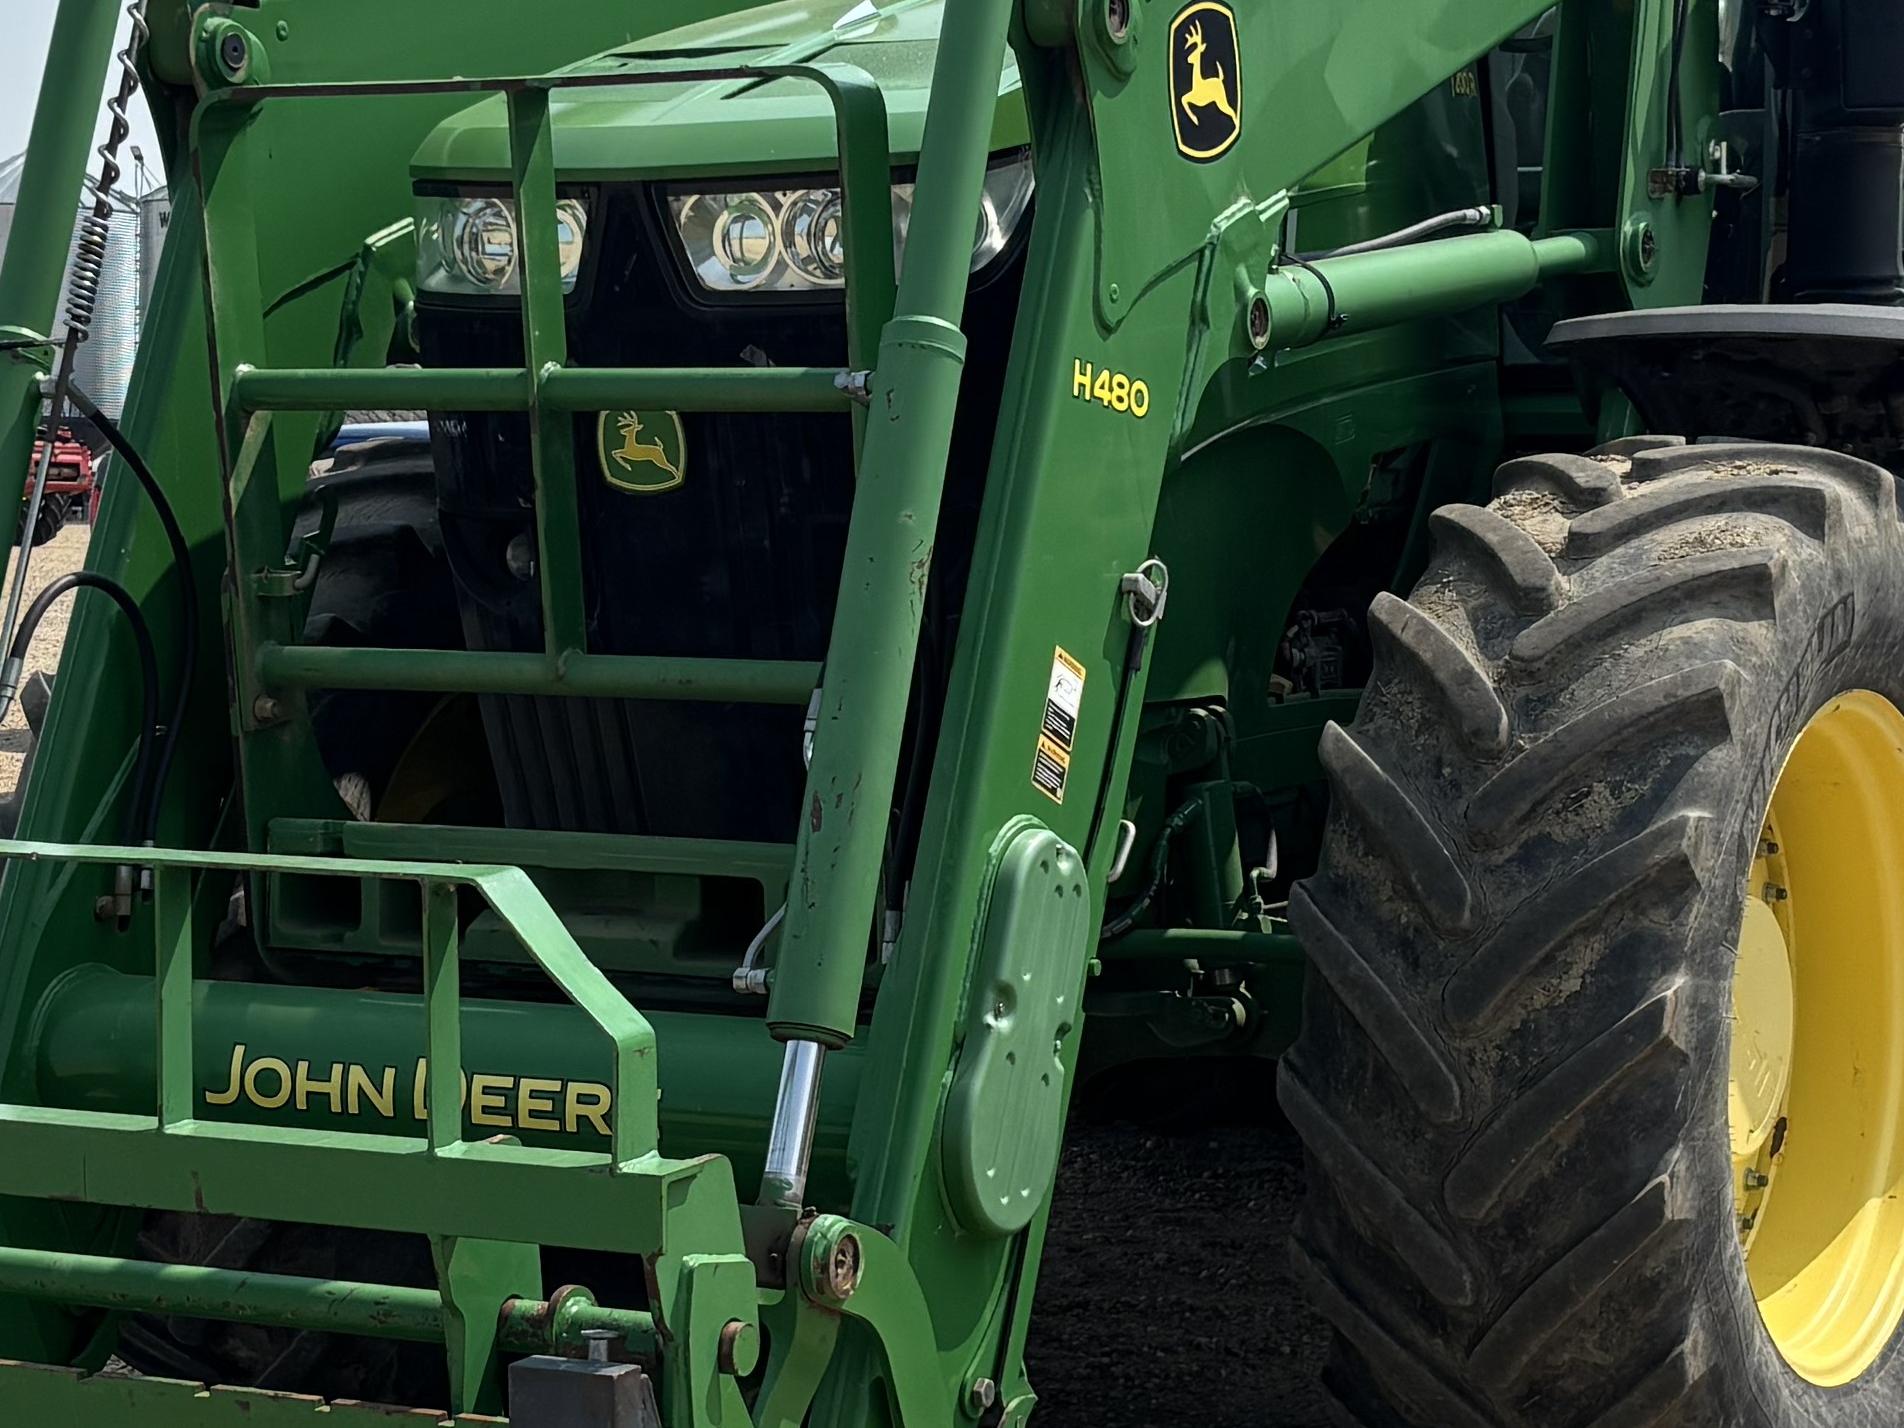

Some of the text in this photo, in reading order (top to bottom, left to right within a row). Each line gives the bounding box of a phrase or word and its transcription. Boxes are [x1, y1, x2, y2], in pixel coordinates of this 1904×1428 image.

[1072, 358, 1150, 418] H480
[205, 1043, 663, 1139] JOHN DEER
